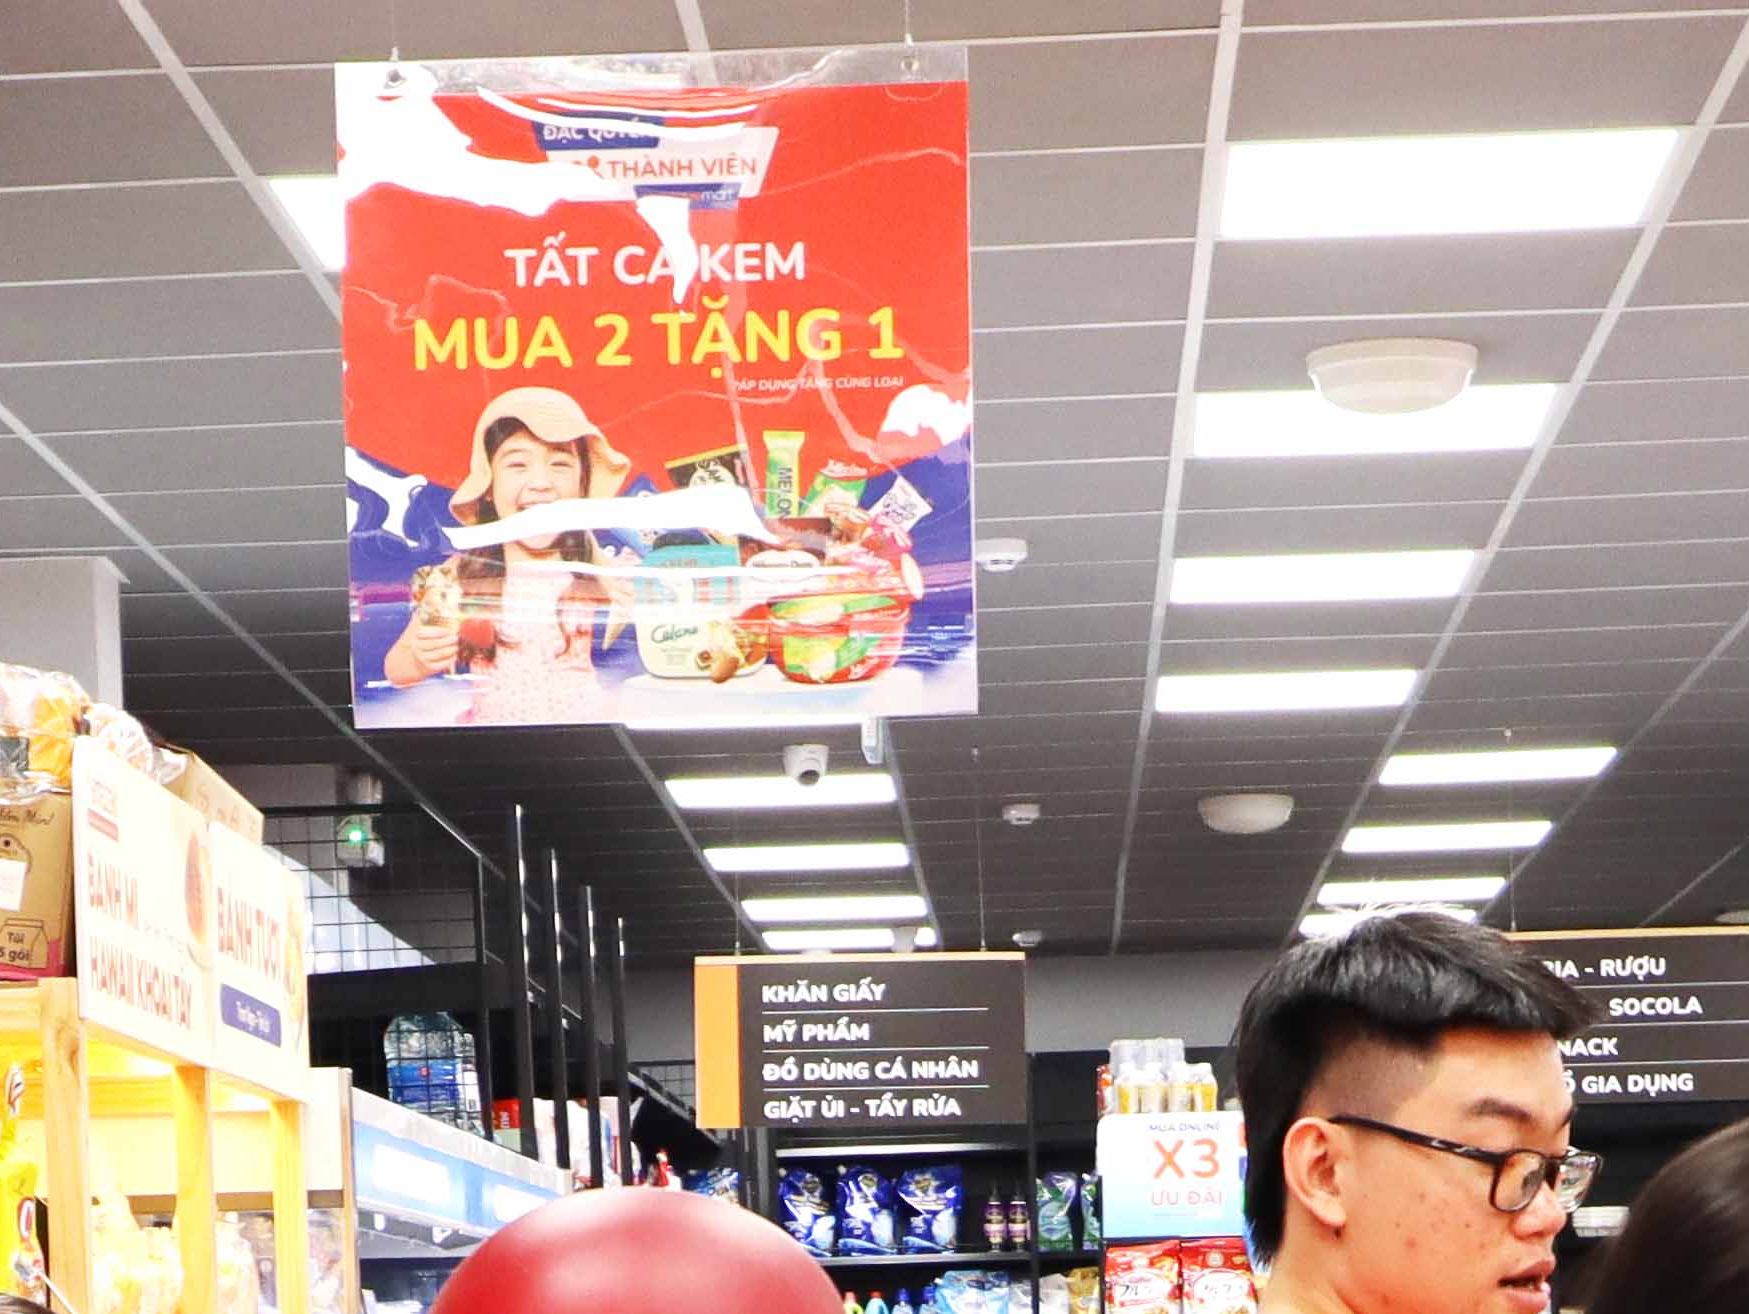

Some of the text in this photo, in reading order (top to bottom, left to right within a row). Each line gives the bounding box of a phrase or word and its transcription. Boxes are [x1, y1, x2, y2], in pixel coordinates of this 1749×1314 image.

[608, 152, 757, 179] THÀNH VIÊN
[503, 231, 600, 287] TẤT
[700, 242, 805, 282] KEM
[414, 296, 903, 378] MUA 2 TẶNG 1
[1600, 955, 1667, 981] RƯỢU
[762, 976, 886, 1003] KHĂN GIẤY
[1609, 996, 1703, 1017] SOCOLA
[763, 1016, 870, 1042] MỸ PHẨM
[1555, 1037, 1619, 1057] NACK
[762, 1055, 978, 1081] ĐỒ DÙNG CÁ NHÂN
[1582, 1074, 1623, 1094] GIA
[1627, 1073, 1694, 1097] DỤNG
[763, 1096, 816, 1123] GIẶT
[821, 1094, 845, 1118] ỦI
[864, 1092, 908, 1117] TẨY
[912, 1093, 962, 1117] RỬA
[1153, 1137, 1221, 1180] X3
